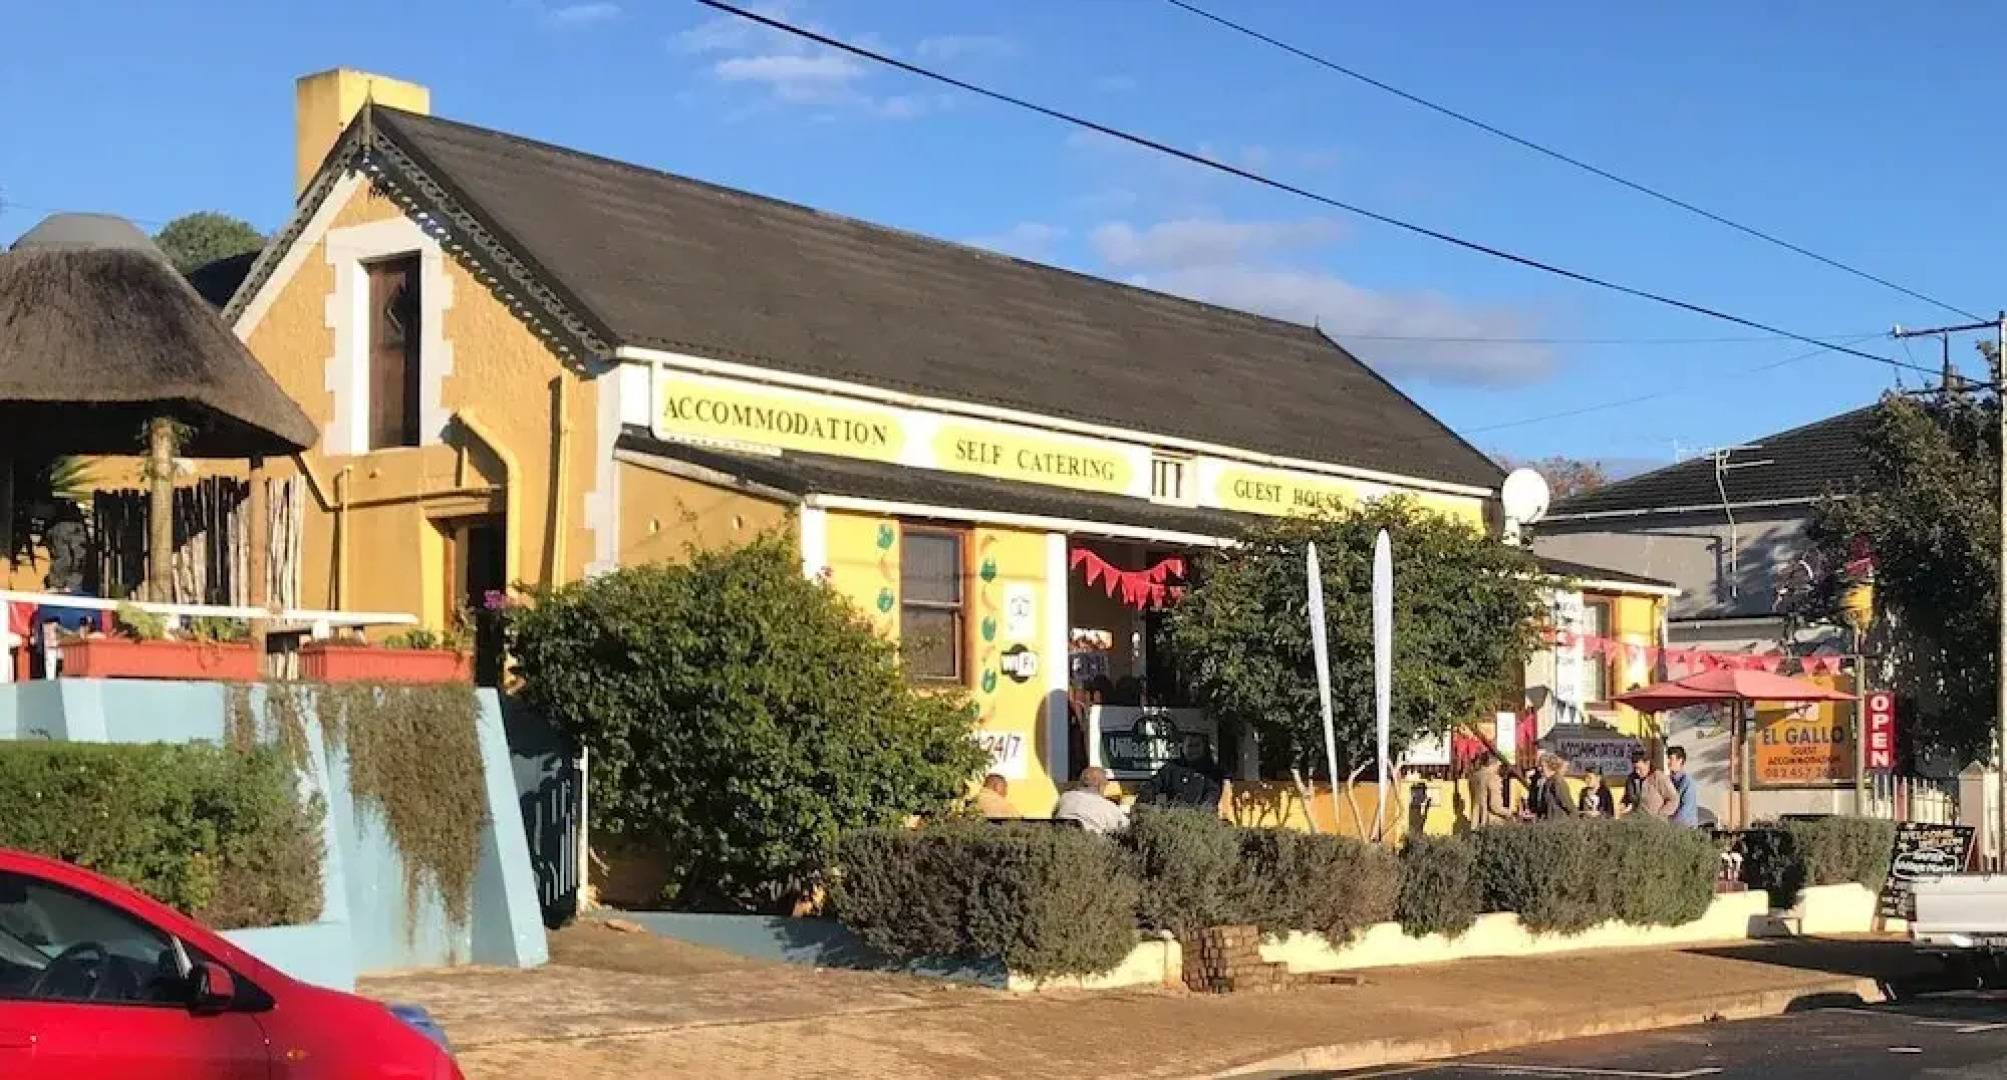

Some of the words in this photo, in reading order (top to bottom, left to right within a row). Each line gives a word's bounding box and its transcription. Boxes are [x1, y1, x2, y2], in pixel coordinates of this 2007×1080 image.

[664, 395, 888, 446] ACCOMMODATION
[955, 438, 1002, 465] SELF
[1017, 449, 1115, 481] CATERING
[1233, 479, 1282, 503] GUEST
[1292, 487, 1343, 511] HOUSE
[1763, 727, 1779, 746] EL
[1785, 726, 1844, 744] GALLO
[1870, 695, 1890, 766] OPEN
